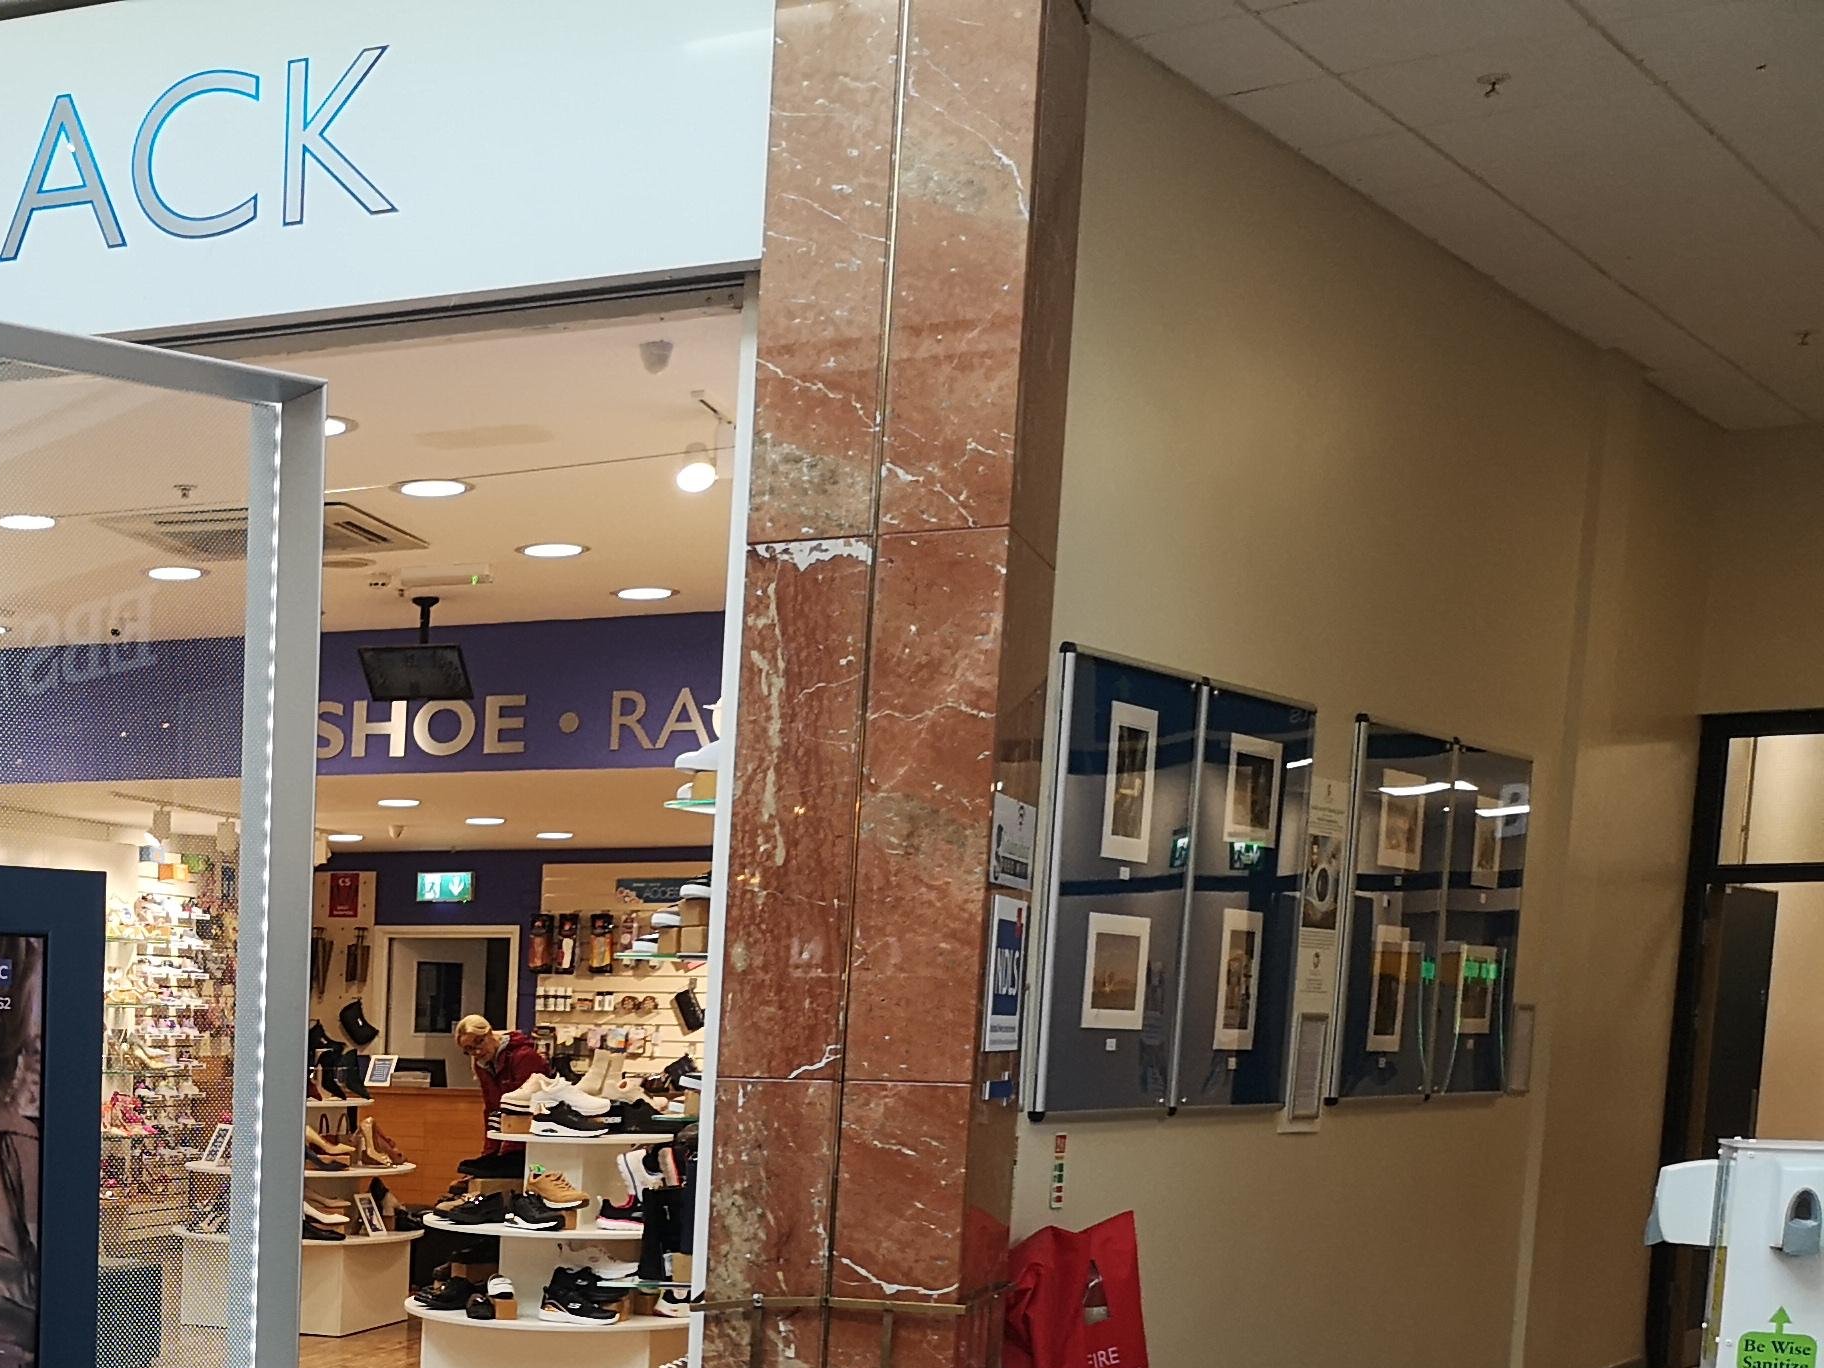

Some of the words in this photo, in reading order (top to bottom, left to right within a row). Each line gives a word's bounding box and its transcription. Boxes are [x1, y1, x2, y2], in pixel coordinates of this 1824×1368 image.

[317, 694, 527, 759] SHOE
[609, 687, 711, 751] RA
[1743, 1339, 1766, 1353] Be
[1771, 1340, 1812, 1356] Wise
